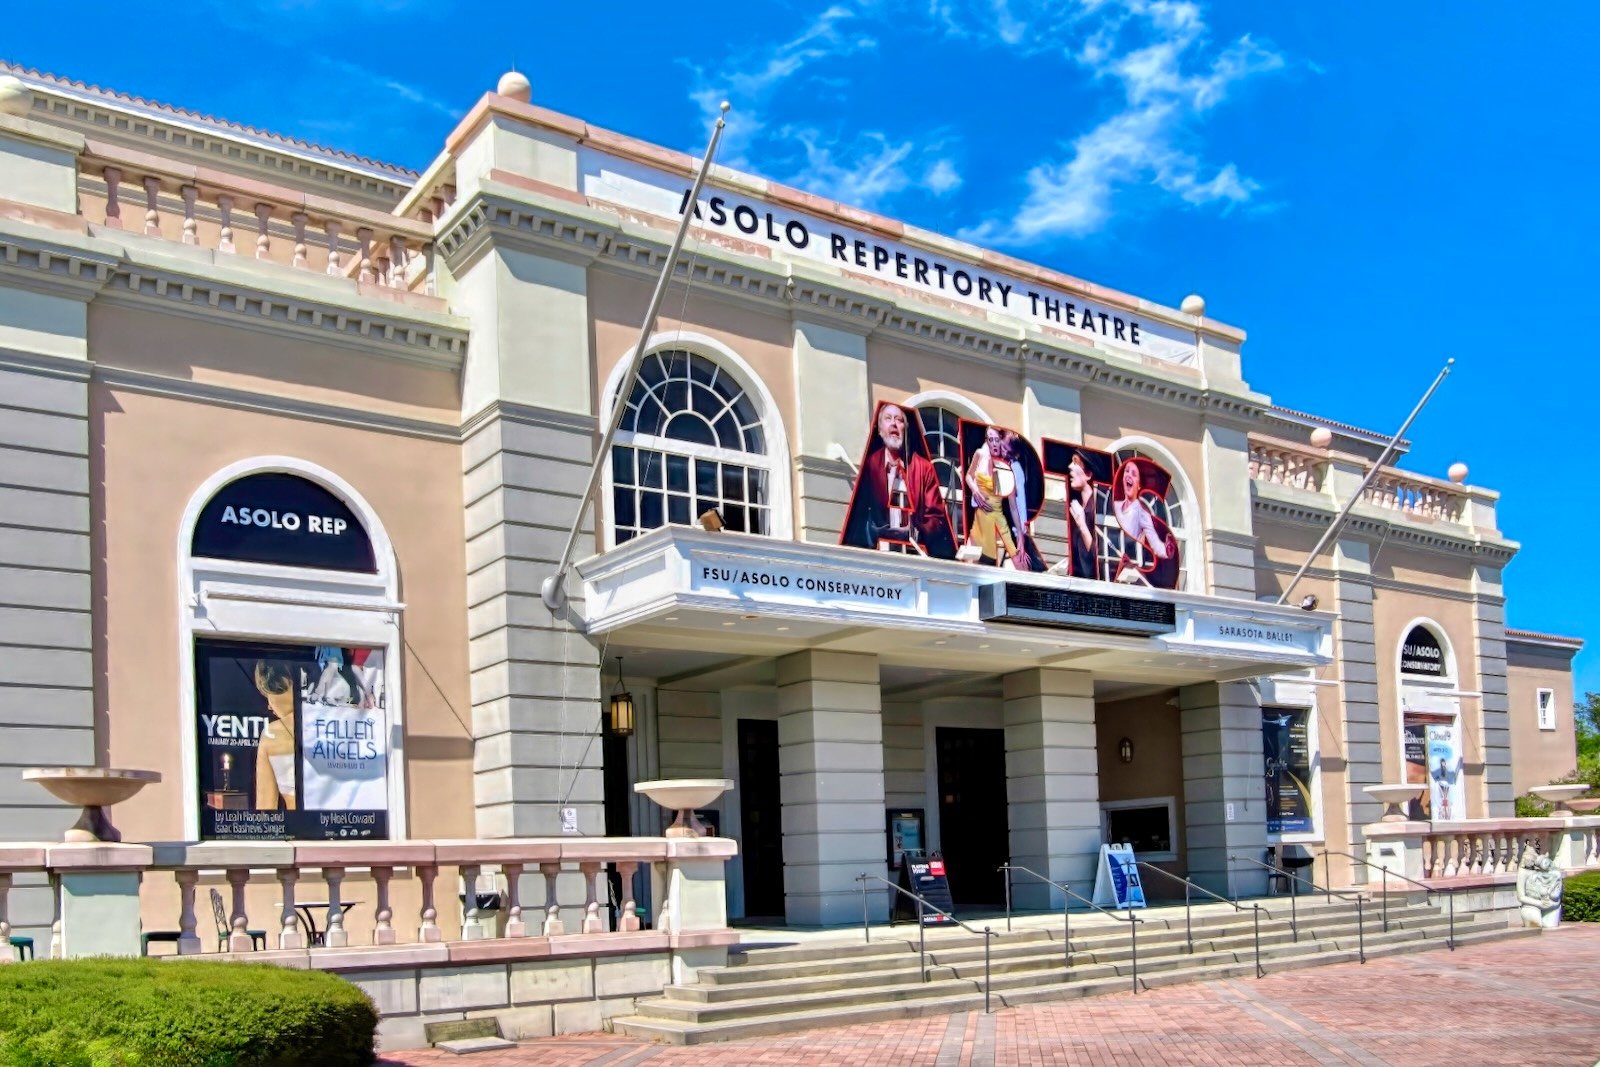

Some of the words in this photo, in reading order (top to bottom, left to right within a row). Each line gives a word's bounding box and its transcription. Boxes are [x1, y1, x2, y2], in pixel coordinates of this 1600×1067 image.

[679, 189, 809, 249] ASOLO
[831, 233, 1012, 307] REPERTORY
[1028, 291, 1141, 345] THEATRE
[839, 400, 1179, 589] ARTS
[221, 505, 300, 531] ASOLO
[308, 514, 347, 536] REP
[703, 567, 790, 588] FSU/ASOLO
[796, 577, 902, 600] CONSERVATORY
[1219, 625, 1262, 639] SARASOTA
[1266, 631, 1293, 643] BALLET
[201, 714, 275, 739] YENTL
[314, 719, 374, 740] FALLEN
[312, 740, 377, 760] ANGELS
[320, 812, 330, 826] by
